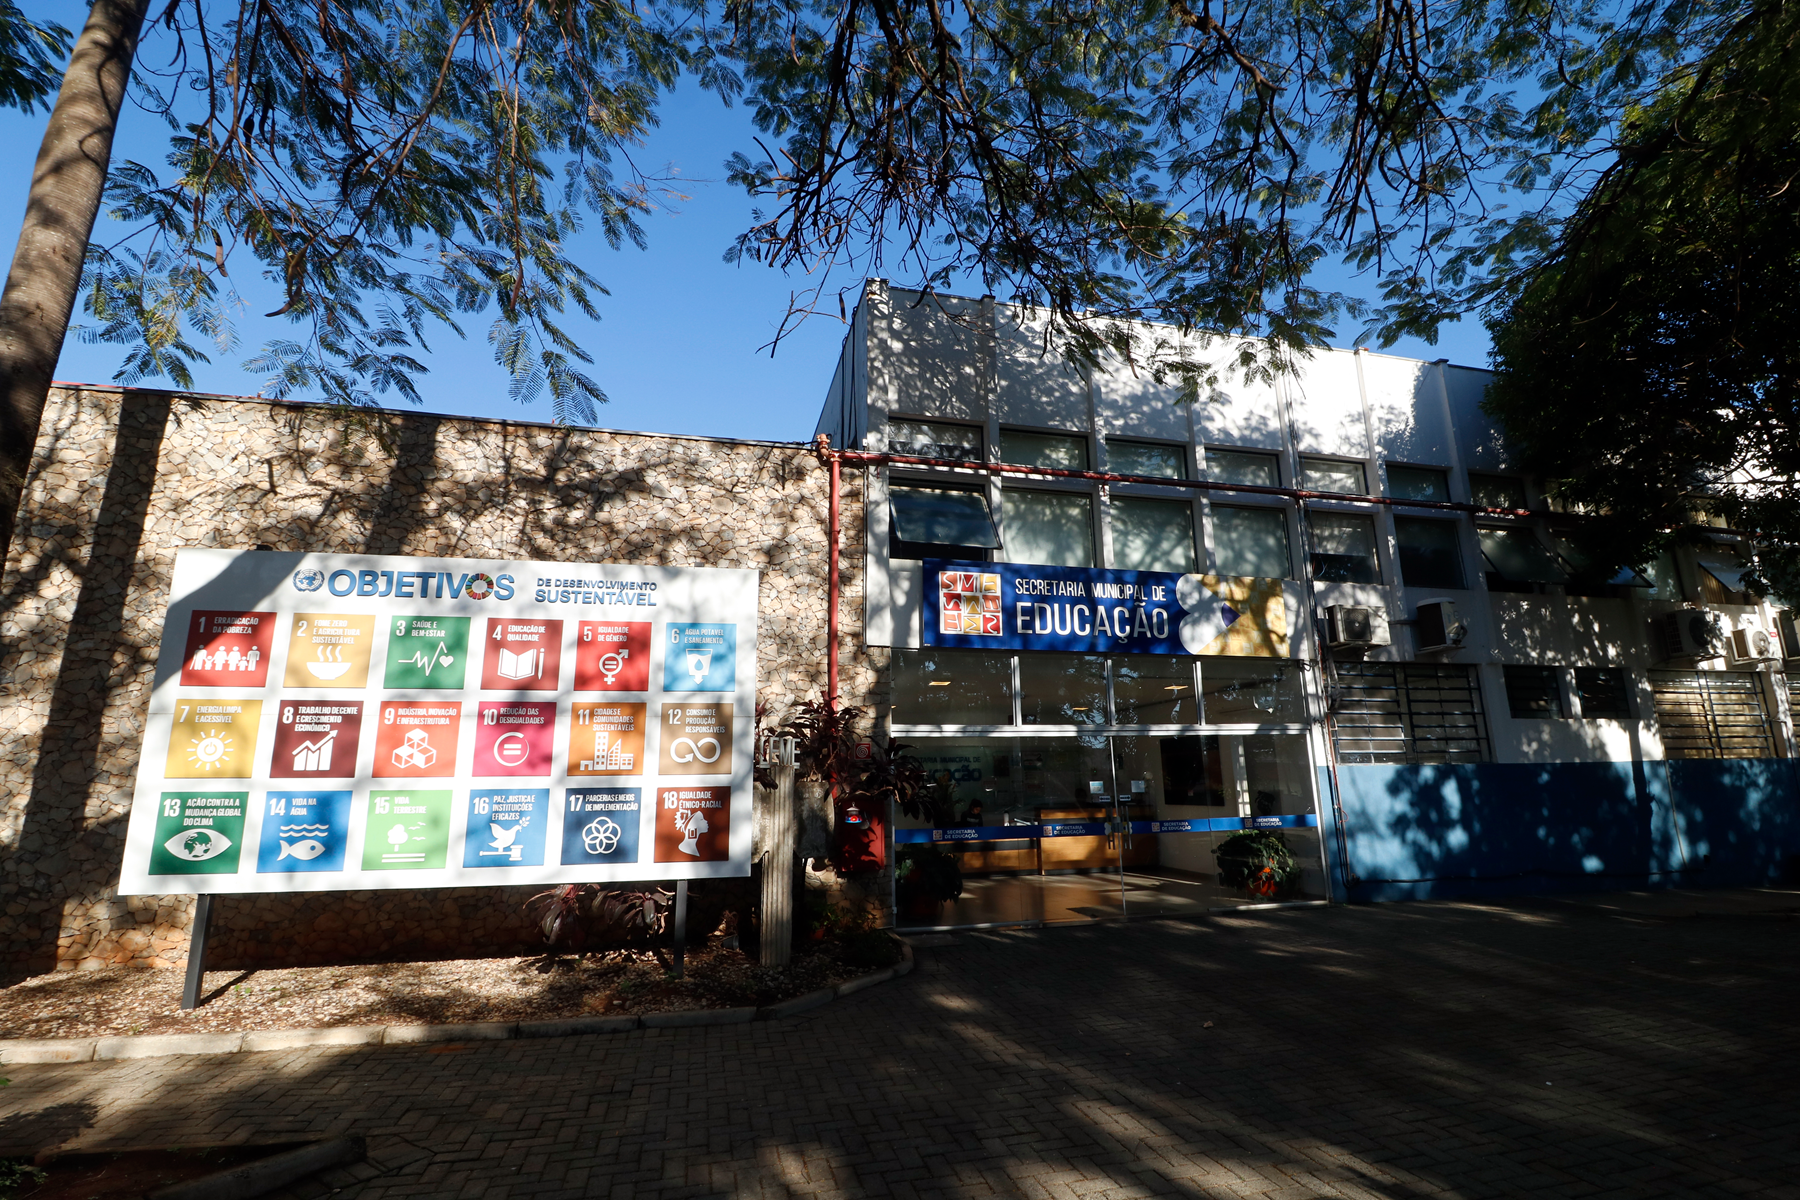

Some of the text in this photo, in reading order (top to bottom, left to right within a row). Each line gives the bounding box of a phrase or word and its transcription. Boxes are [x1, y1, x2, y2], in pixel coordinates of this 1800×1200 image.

[328, 569, 515, 601] OBJETIVOS
[537, 578, 657, 591] DE DESENVOLVIMENTO
[1016, 578, 1166, 601] SECRETARIA MUNICIPAL DE
[535, 589, 656, 606] SUSTENTÁVEL
[199, 617, 206, 633] 1
[214, 617, 258, 625] ERRADICAÇÃO
[396, 620, 406, 636] 3
[412, 620, 431, 628] SAÚDE
[1016, 602, 1169, 644] EDUCAÇÃO
[297, 621, 307, 637] 2
[492, 625, 502, 640] 4
[508, 625, 538, 633] EDUCAÇÃO
[584, 626, 592, 641] 5
[672, 628, 679, 643] 6
[312, 636, 354, 644] SUSTENTÁVEL
[606, 634, 627, 642] GÊNERO
[180, 706, 190, 722] 7
[283, 707, 294, 724] 8
[384, 708, 394, 724] 9
[428, 708, 456, 716] INOVAÇÃO
[483, 709, 497, 725] 10
[500, 707, 526, 715] REDUÇÃO
[578, 709, 589, 725] 11
[668, 709, 681, 724] 12
[200, 715, 232, 723] ACESSÍVEL
[686, 716, 715, 725] PRODUÇÃO
[593, 723, 634, 731] SUSTENTÁVEIS
[686, 725, 725, 733] RESPONSÁVEIS
[186, 798, 206, 807] AÇÃO
[507, 795, 530, 803] JUSTIÇA
[570, 795, 583, 811] 17
[586, 794, 614, 802] PARCERIAS
[663, 791, 677, 809] 18
[679, 800, 722, 808] ÉTNICO-RACIAL
[164, 799, 180, 817] 13
[270, 798, 286, 816] 14
[290, 807, 307, 815] ÁGUA
[374, 797, 390, 814] 15
[394, 806, 427, 814] TERRESTRE
[473, 797, 489, 814] 16
[493, 803, 532, 812] INSTITUIÇÕES
[593, 802, 638, 811] IMPLEMENTAÇÃO
[185, 809, 216, 817] MUDANÇA
[184, 818, 193, 826] DO
